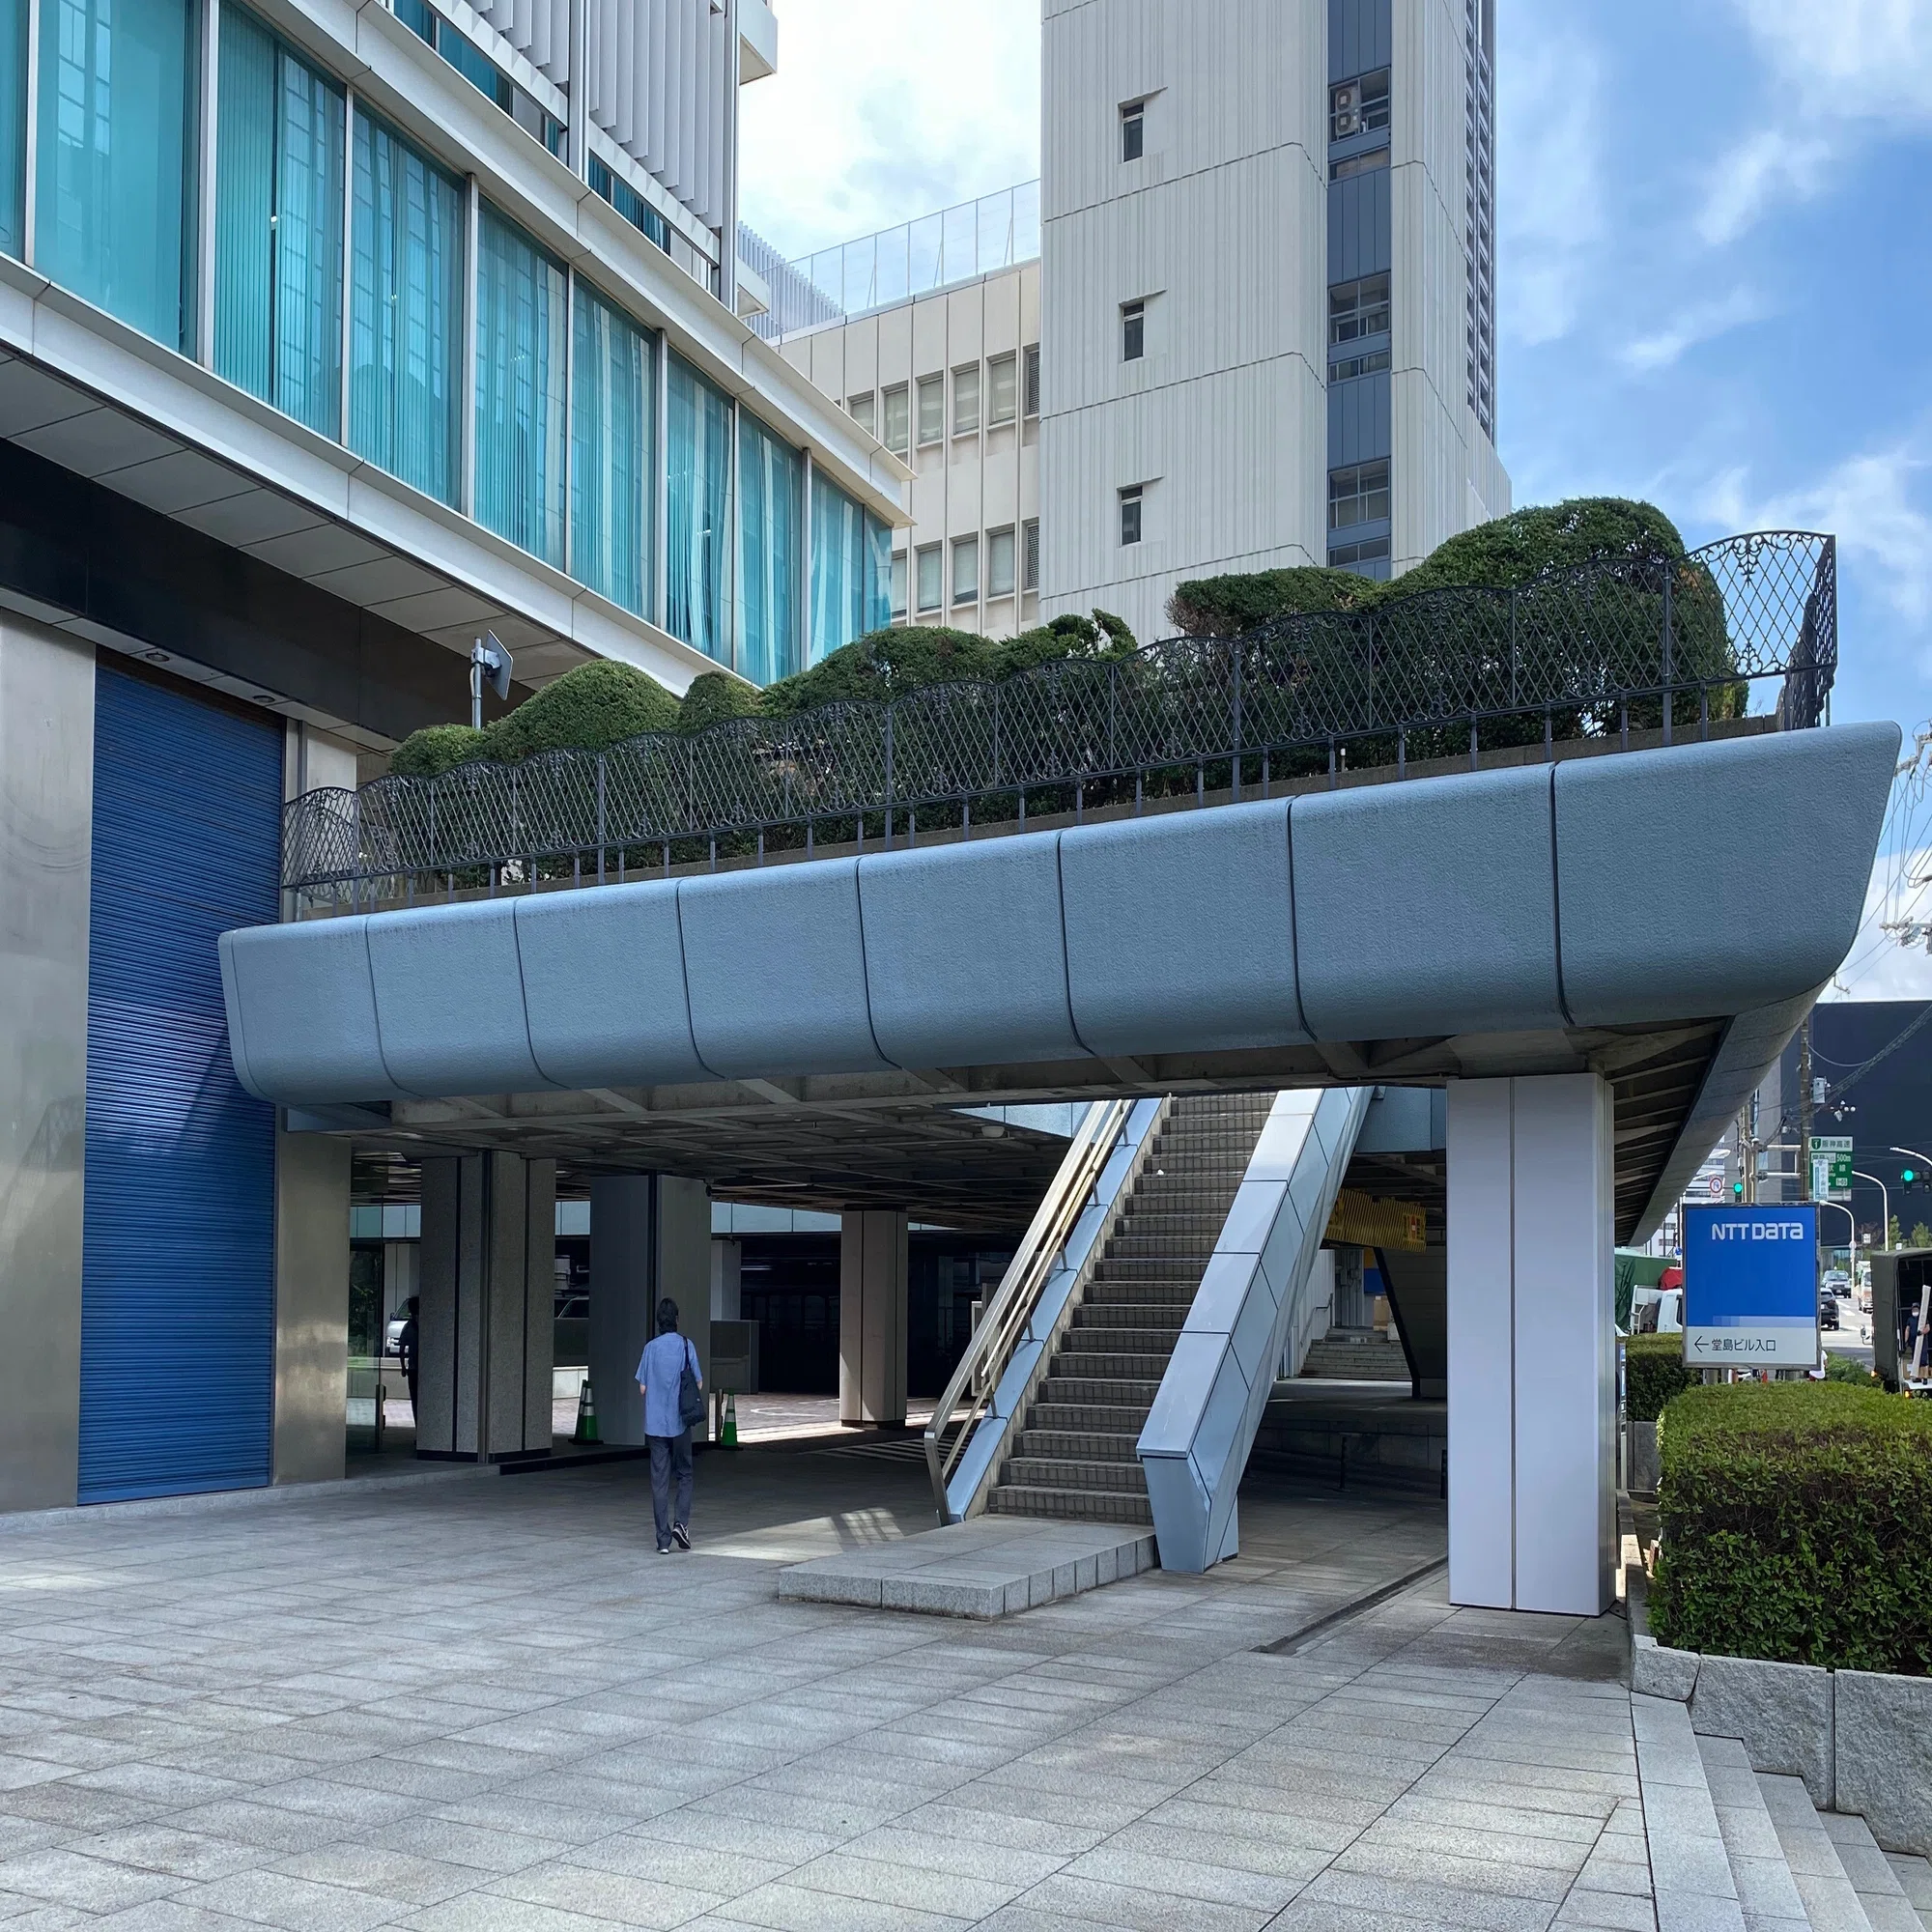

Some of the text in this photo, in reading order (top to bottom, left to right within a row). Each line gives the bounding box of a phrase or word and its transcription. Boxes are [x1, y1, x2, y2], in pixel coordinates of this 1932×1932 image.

[1712, 1223, 1749, 1239] NTT
[1712, 1338, 1776, 1351] 堂島ビル入口
